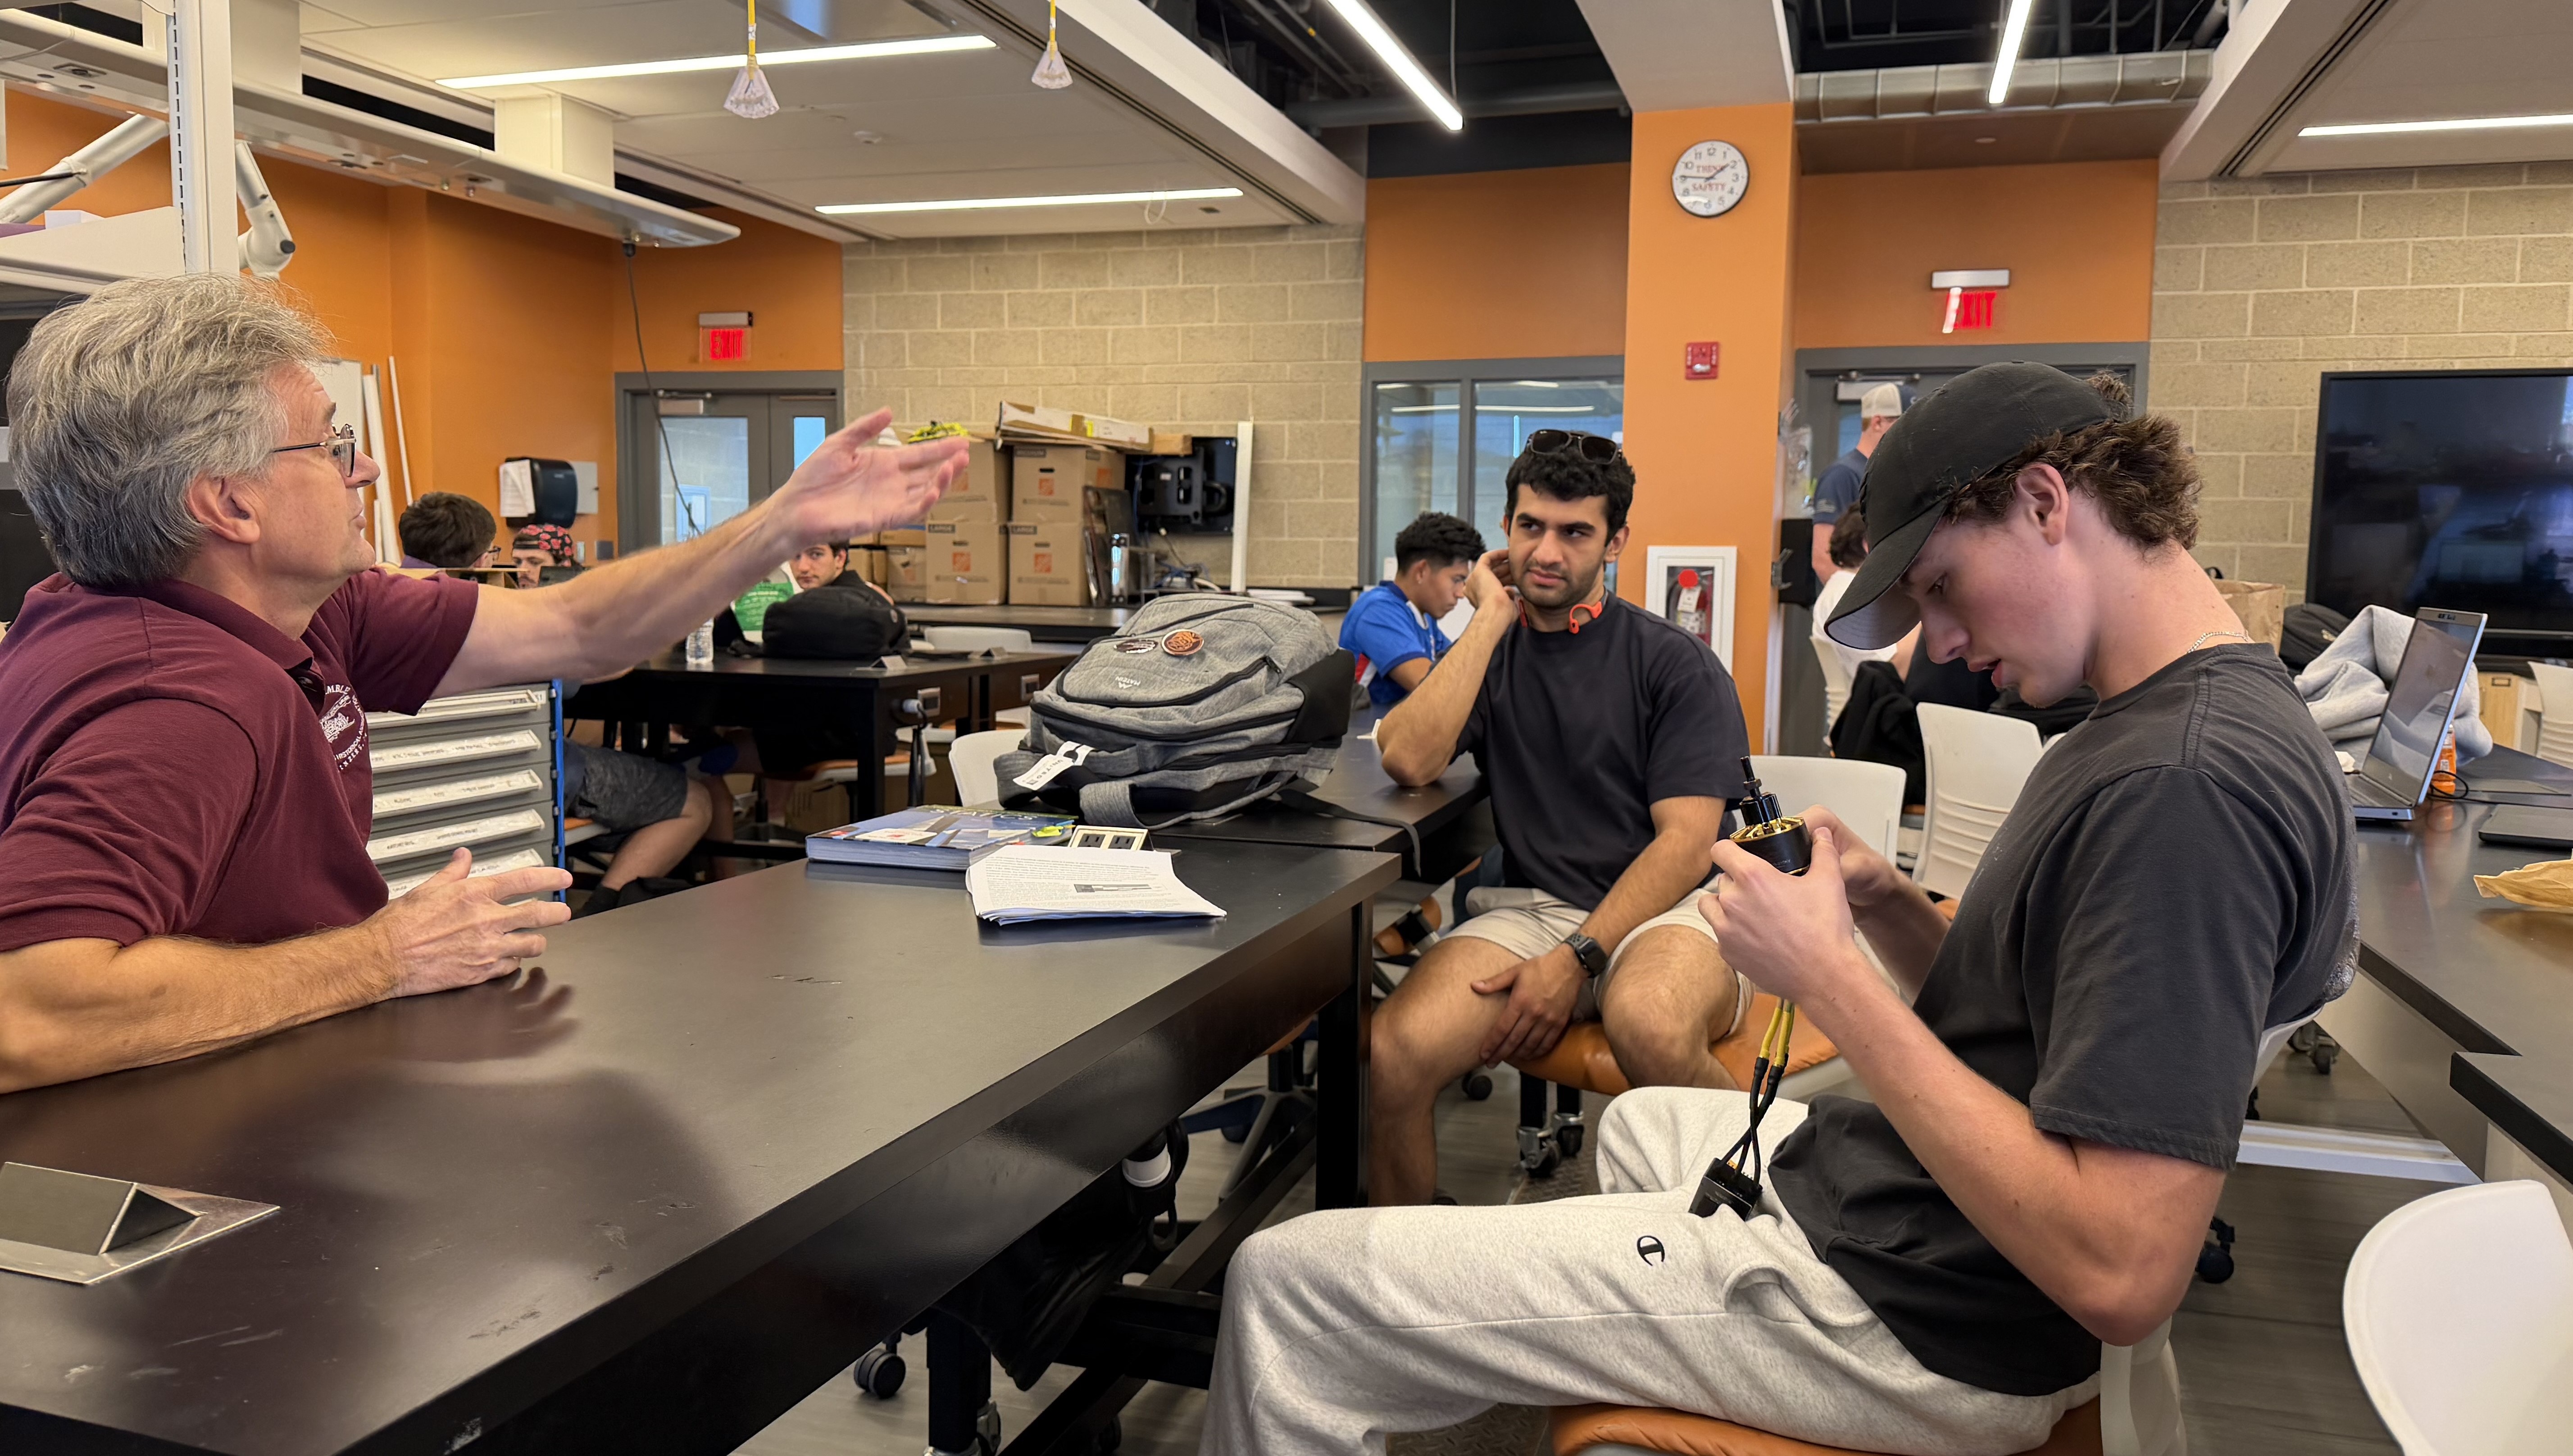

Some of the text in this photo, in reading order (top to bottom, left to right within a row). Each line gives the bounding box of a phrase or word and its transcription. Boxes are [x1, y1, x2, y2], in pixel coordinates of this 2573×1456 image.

[1694, 151, 1702, 160] 11
[1707, 147, 1717, 156] 12
[1723, 150, 1727, 159] 1
[1684, 161, 1694, 170] 10
[1729, 159, 1738, 169] 2
[1732, 173, 1739, 182] 3
[1692, 182, 1726, 191] SAFETY
[1718, 196, 1725, 205] 5
[710, 329, 744, 360] EXIT
[1115, 676, 1141, 686] MATEIN
[325, 684, 351, 694] MBLE
[1036, 759, 1064, 780] UNITED
[929, 809, 1038, 820] STATICS
